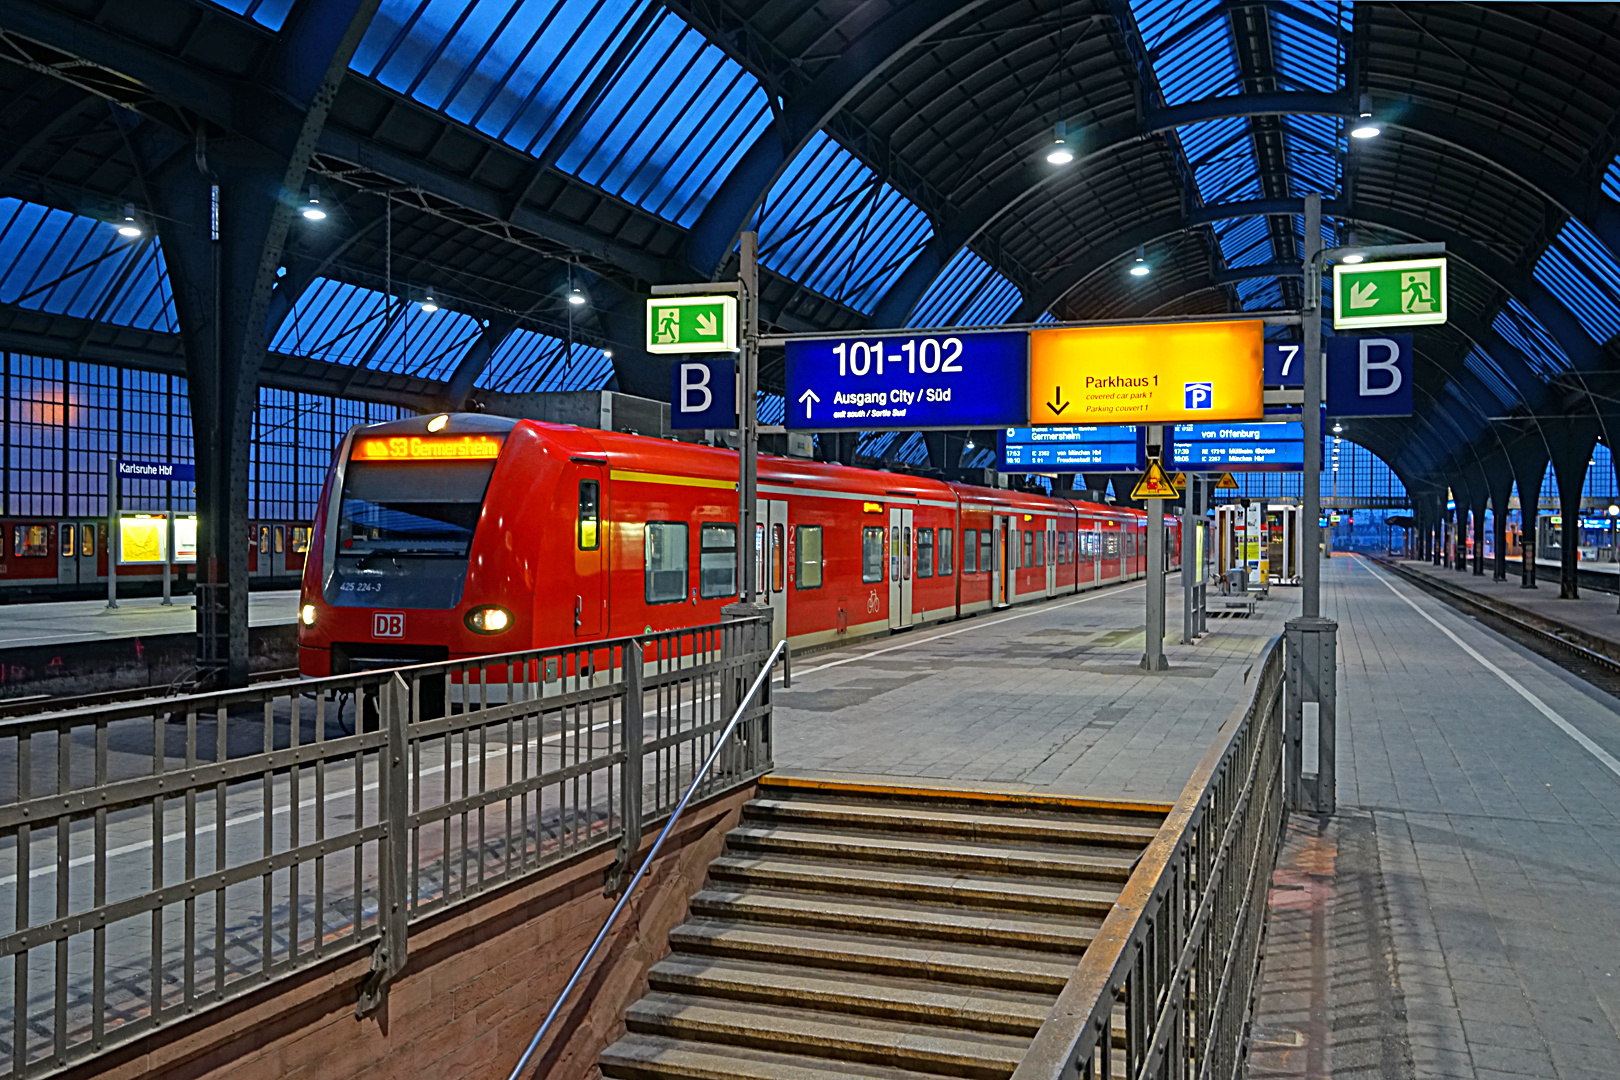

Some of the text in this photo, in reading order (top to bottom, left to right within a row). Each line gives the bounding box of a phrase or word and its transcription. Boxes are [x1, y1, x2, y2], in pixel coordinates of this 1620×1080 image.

[832, 337, 963, 376] 101-102
[1278, 345, 1299, 376] 7
[1359, 338, 1402, 396] B
[681, 363, 712, 412] B
[1086, 375, 1158, 388] Parkhaus 1
[833, 387, 951, 406] Ausgang City / Süd
[1086, 392, 1115, 401] covered
[1130, 391, 1147, 401] park
[1149, 391, 1153, 399] 1
[1192, 389, 1207, 409] P
[847, 409, 866, 418] south
[871, 408, 892, 417] Sortie
[1086, 404, 1113, 414] Parking
[1115, 404, 1144, 412] couvert
[1031, 432, 1081, 440] Germersheim
[1219, 430, 1260, 440] Offenburg
[389, 436, 498, 456] S3 Germersheim
[120, 463, 173, 475] Karlsruhe Hbf
[789, 526, 795, 544] 2
[884, 528, 889, 543] 2
[913, 528, 918, 543] 2
[339, 582, 382, 592] 425 224-3
[376, 616, 401, 635] DB
